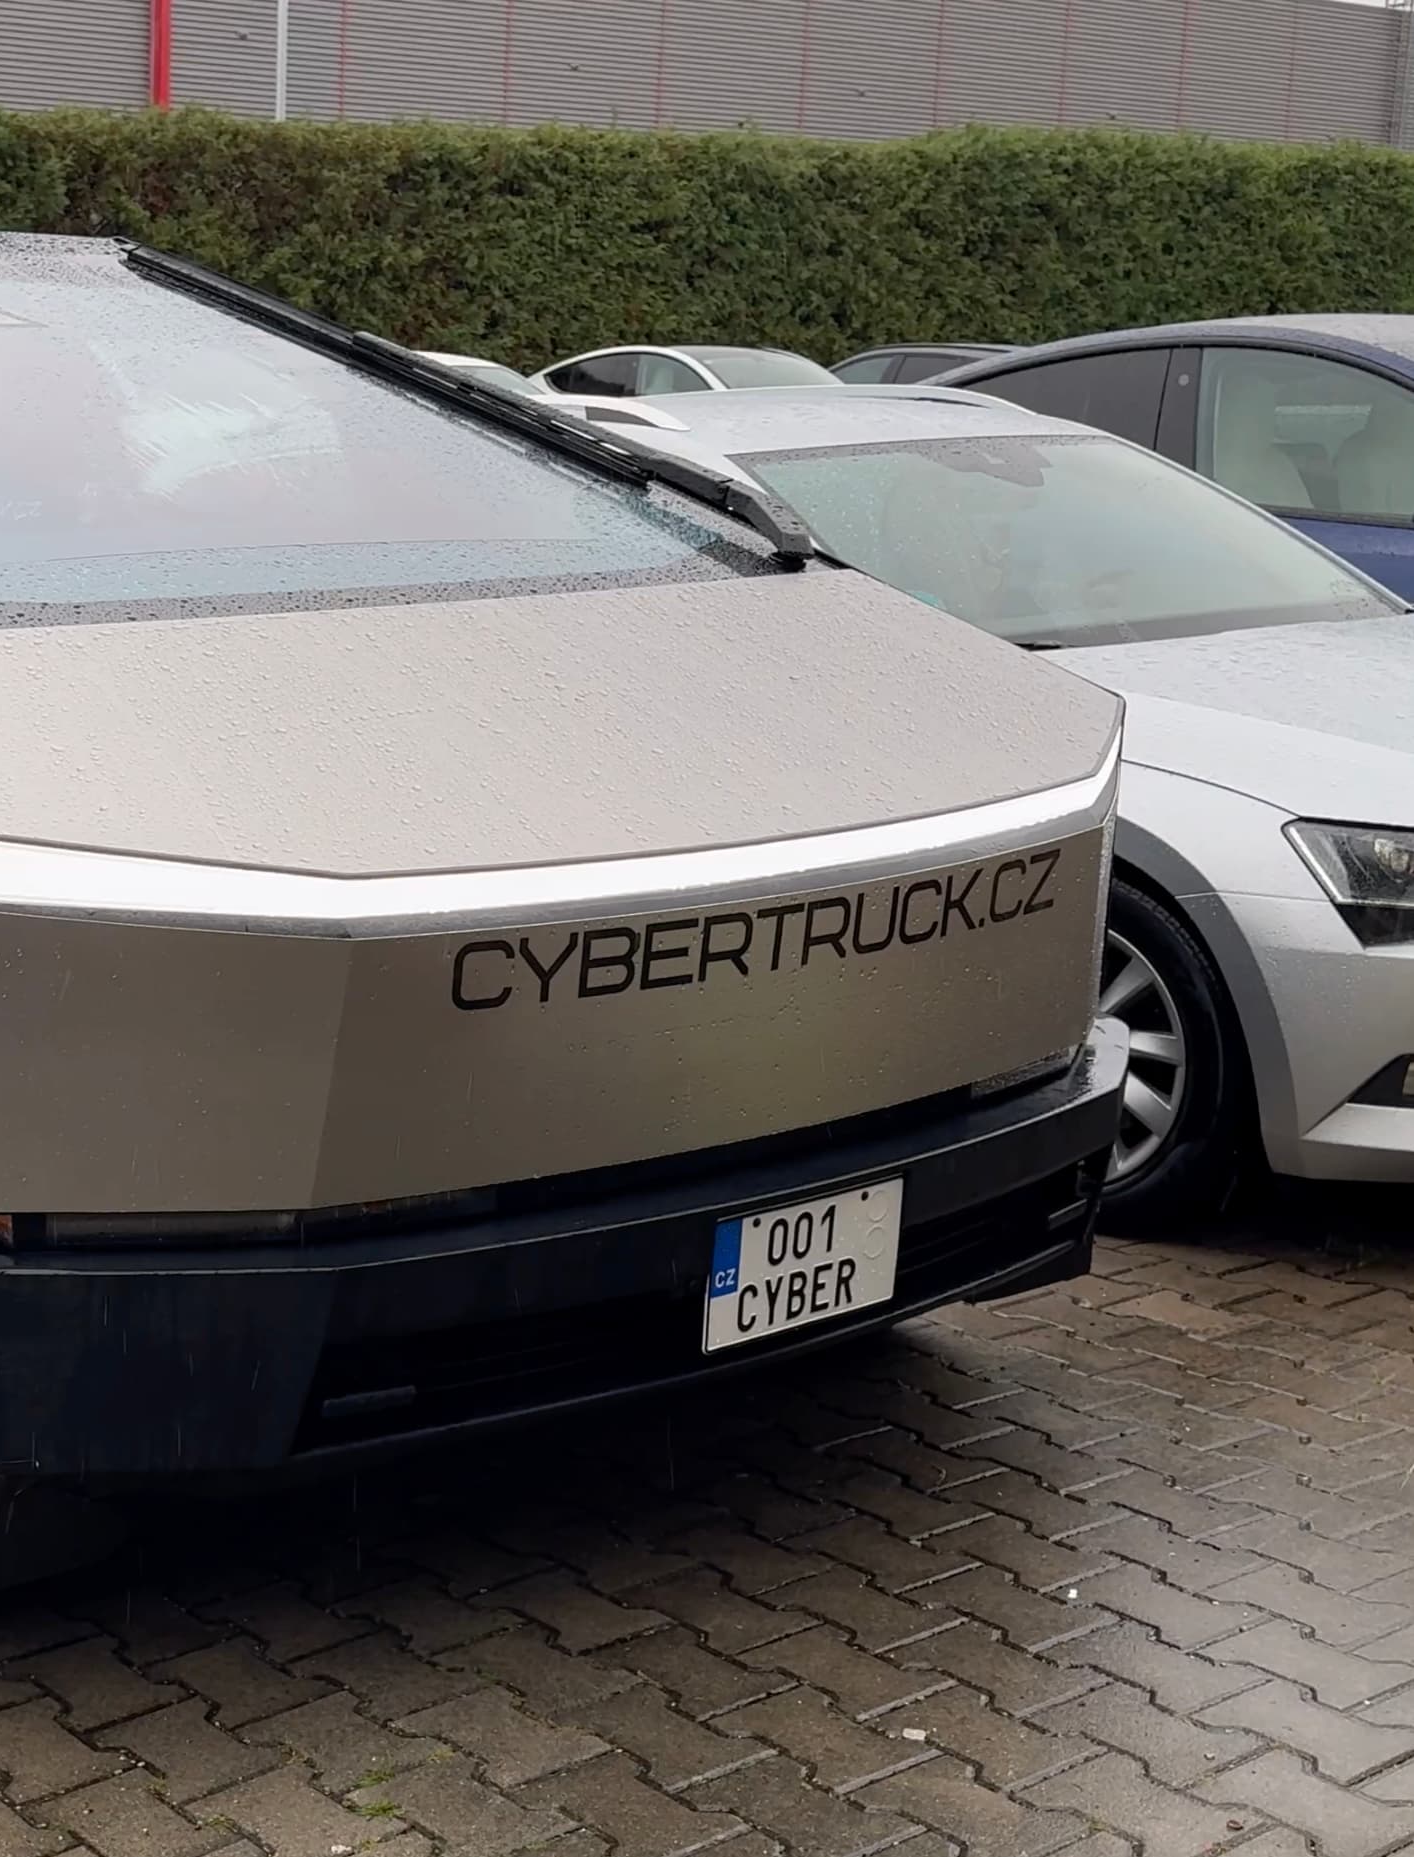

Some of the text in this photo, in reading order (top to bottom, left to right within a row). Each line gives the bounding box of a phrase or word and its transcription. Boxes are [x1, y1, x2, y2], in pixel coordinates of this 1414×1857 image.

[450, 848, 1062, 1011] CYBERTRUCK.CZ
[767, 1204, 837, 1266] 001
[714, 1268, 736, 1288] CZ
[737, 1257, 856, 1333] CYBER
